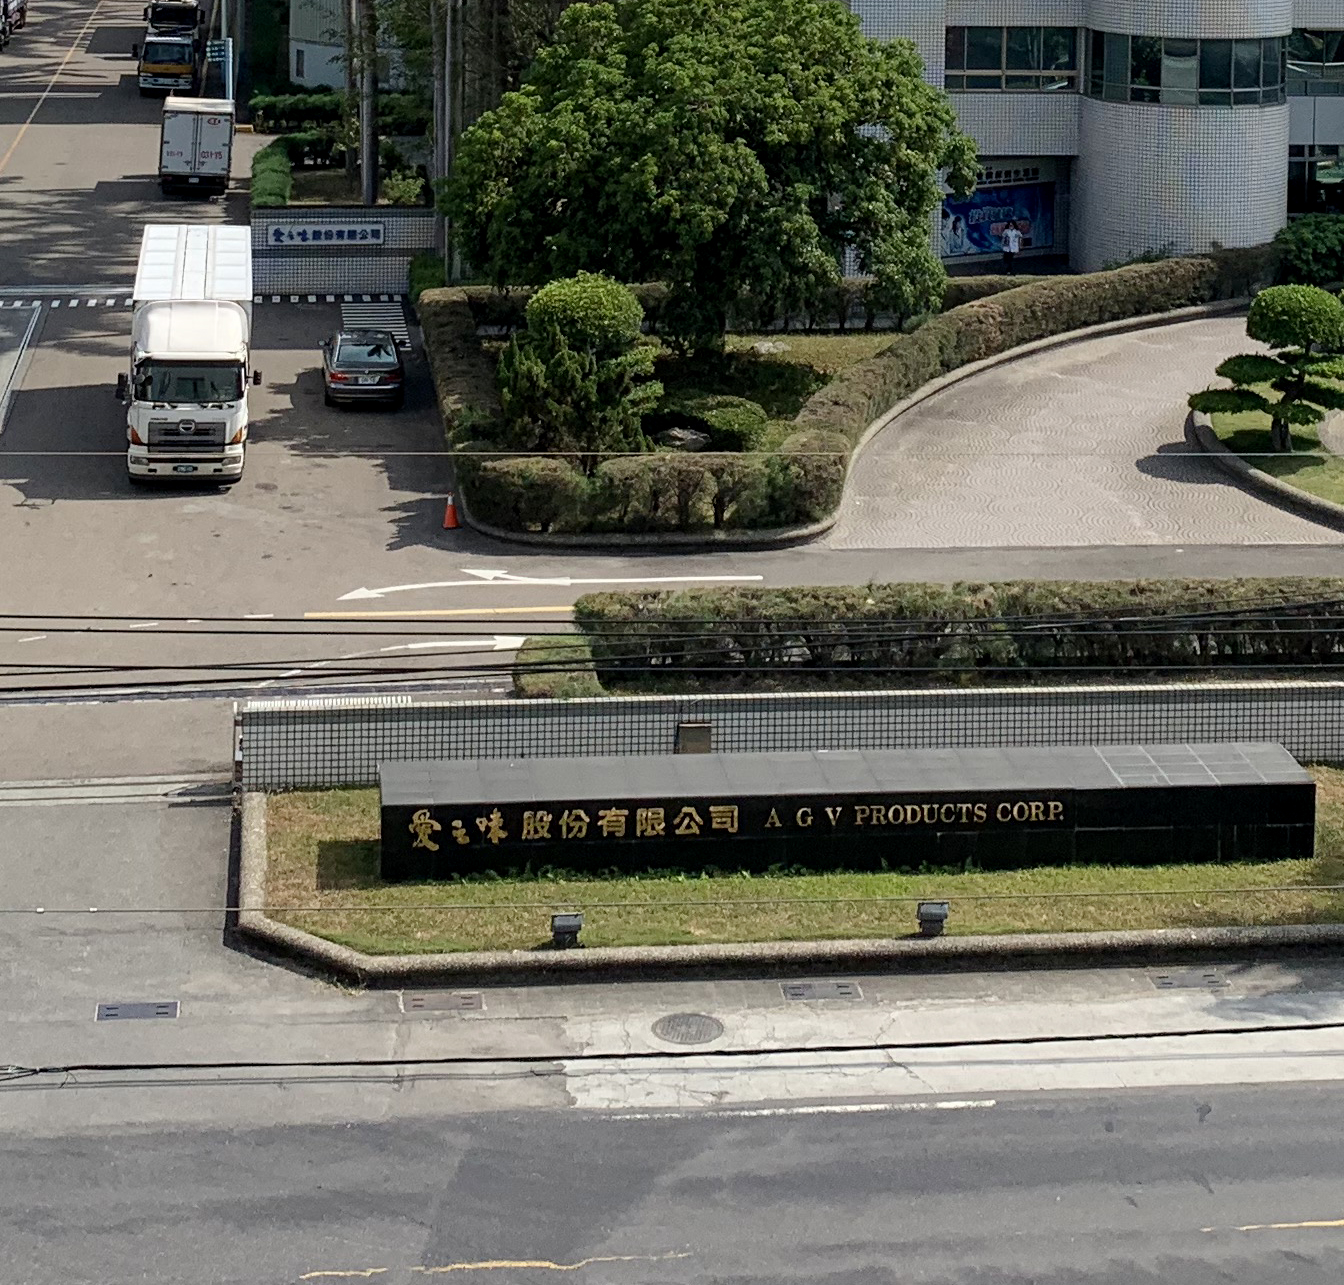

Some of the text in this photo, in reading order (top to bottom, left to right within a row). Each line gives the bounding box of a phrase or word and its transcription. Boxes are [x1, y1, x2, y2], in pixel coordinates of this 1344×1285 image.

[409, 805, 739, 851] 愛之味股份有限公司
[764, 801, 1064, 828] A G V PRODUCTS CORP.
